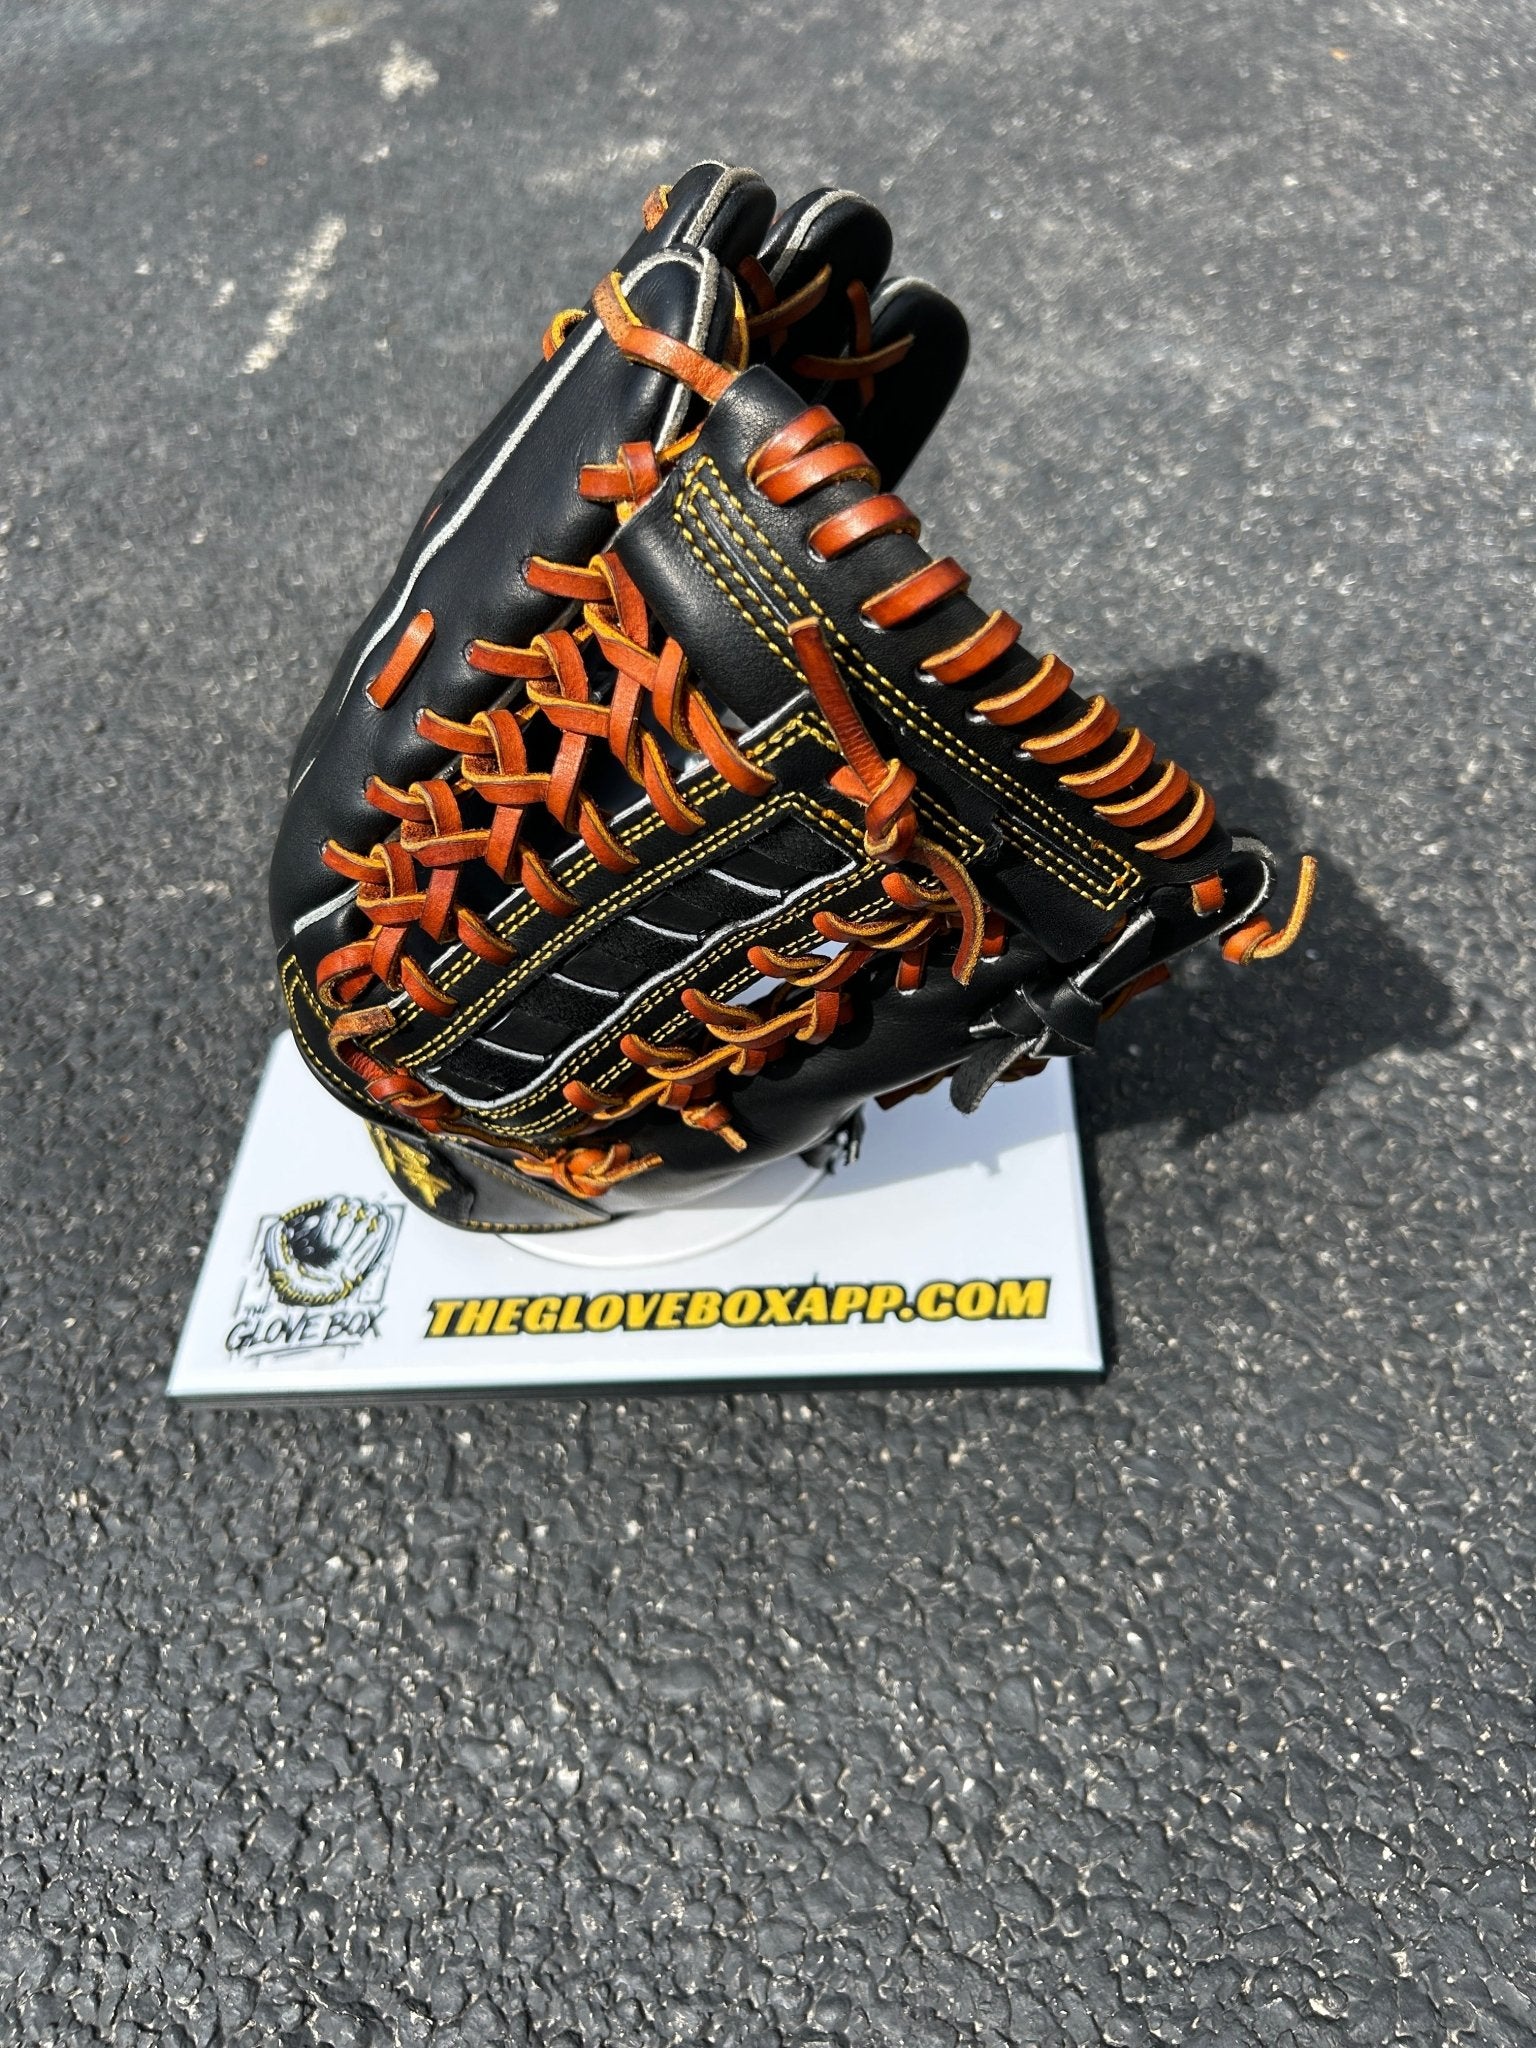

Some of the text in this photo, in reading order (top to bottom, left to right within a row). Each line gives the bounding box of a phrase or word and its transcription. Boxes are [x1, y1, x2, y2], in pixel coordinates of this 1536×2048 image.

[225, 1305, 387, 1351] GLOVE BOX
[426, 1278, 1050, 1337] THEGLOVEBOXAPP.COM
